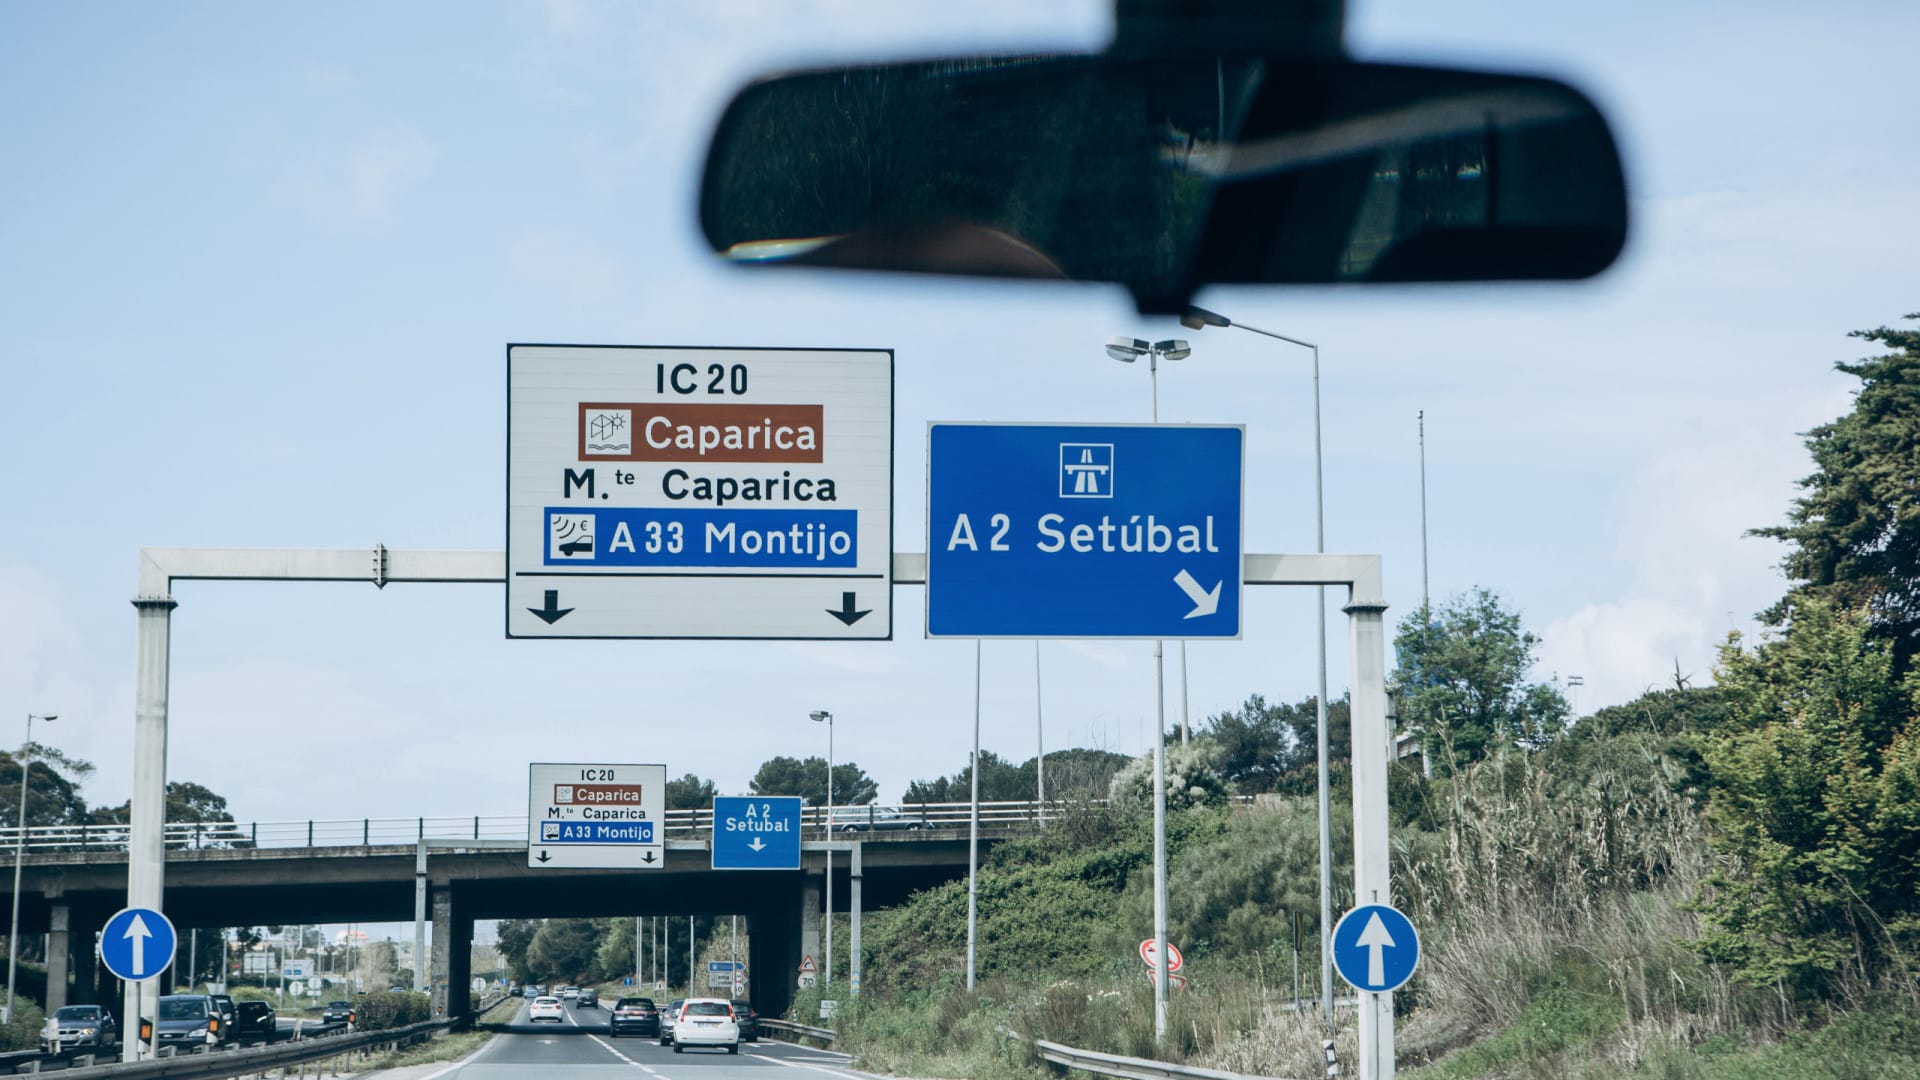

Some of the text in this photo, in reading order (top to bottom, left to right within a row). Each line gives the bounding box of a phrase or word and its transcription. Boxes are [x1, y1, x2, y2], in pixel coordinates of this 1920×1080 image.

[656, 363, 749, 396] IC 20
[645, 416, 817, 455] Caparica
[662, 468, 838, 506] Caparica
[946, 512, 1219, 554] A 2 Setúbal
[609, 521, 851, 561] A 33 Montijo
[581, 769, 615, 782] IC 20
[577, 788, 640, 803] Caparica
[583, 807, 646, 821] Caparica
[745, 803, 771, 818] A 2
[563, 826, 652, 841] A 33 Montijo
[801, 977, 814, 986] 70
